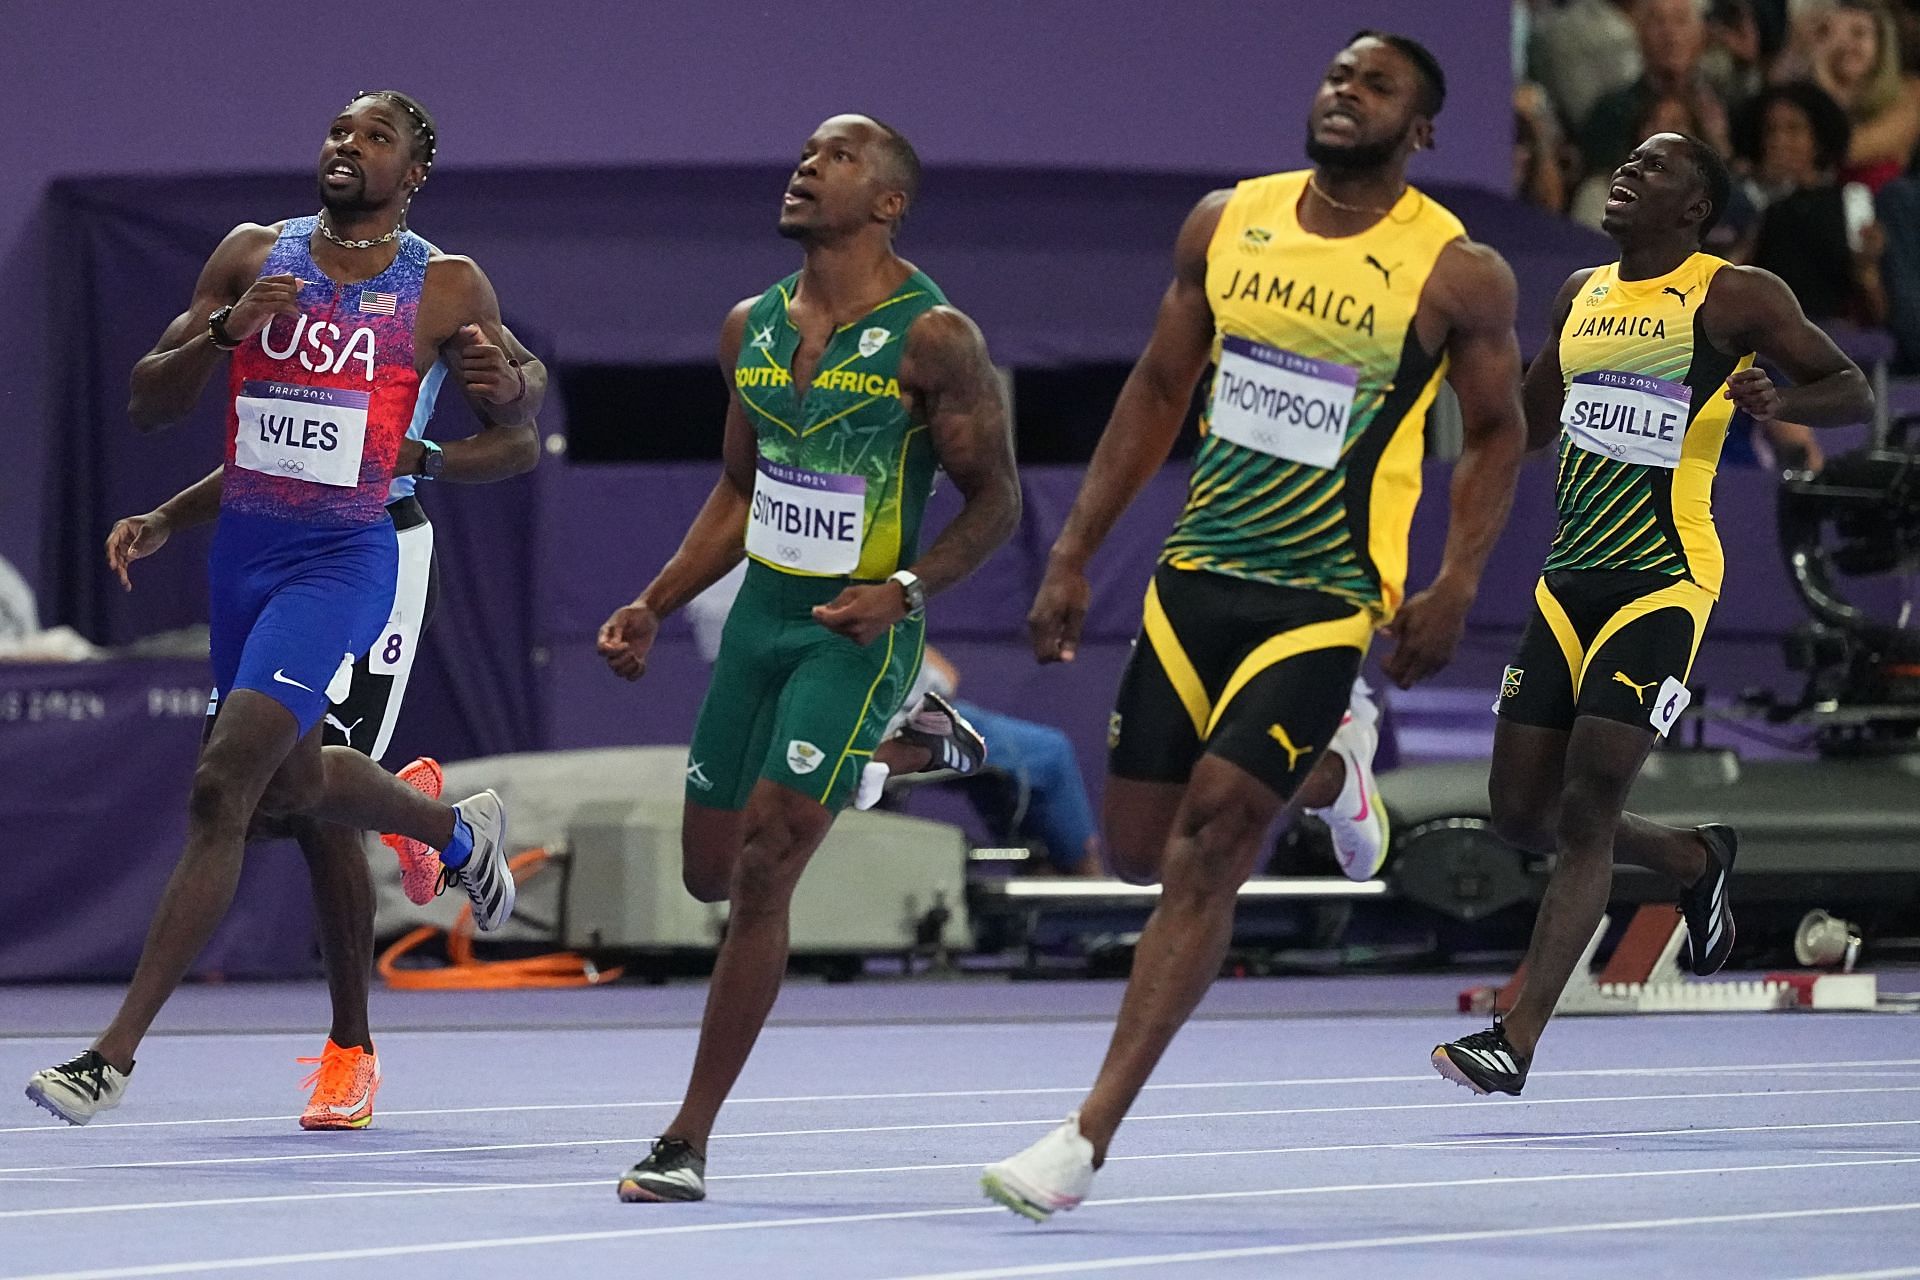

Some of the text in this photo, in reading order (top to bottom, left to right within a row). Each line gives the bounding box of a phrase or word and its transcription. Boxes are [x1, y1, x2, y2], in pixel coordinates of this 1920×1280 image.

[1221, 270, 1375, 337] JAMAICA
[1572, 317, 1665, 339] JAMAICA
[261, 313, 376, 382] USA
[302, 389, 334, 401] 2024
[813, 370, 901, 400] AFRICA
[1629, 377, 1659, 391] 2024
[1220, 371, 1345, 434] THOMPSON
[260, 413, 340, 452] LYLES
[1570, 401, 1677, 441] SEVILLE
[796, 472, 828, 487] 2024
[752, 489, 856, 542] SIMBINE
[382, 633, 402, 665] 8
[1663, 693, 1678, 722] 6
